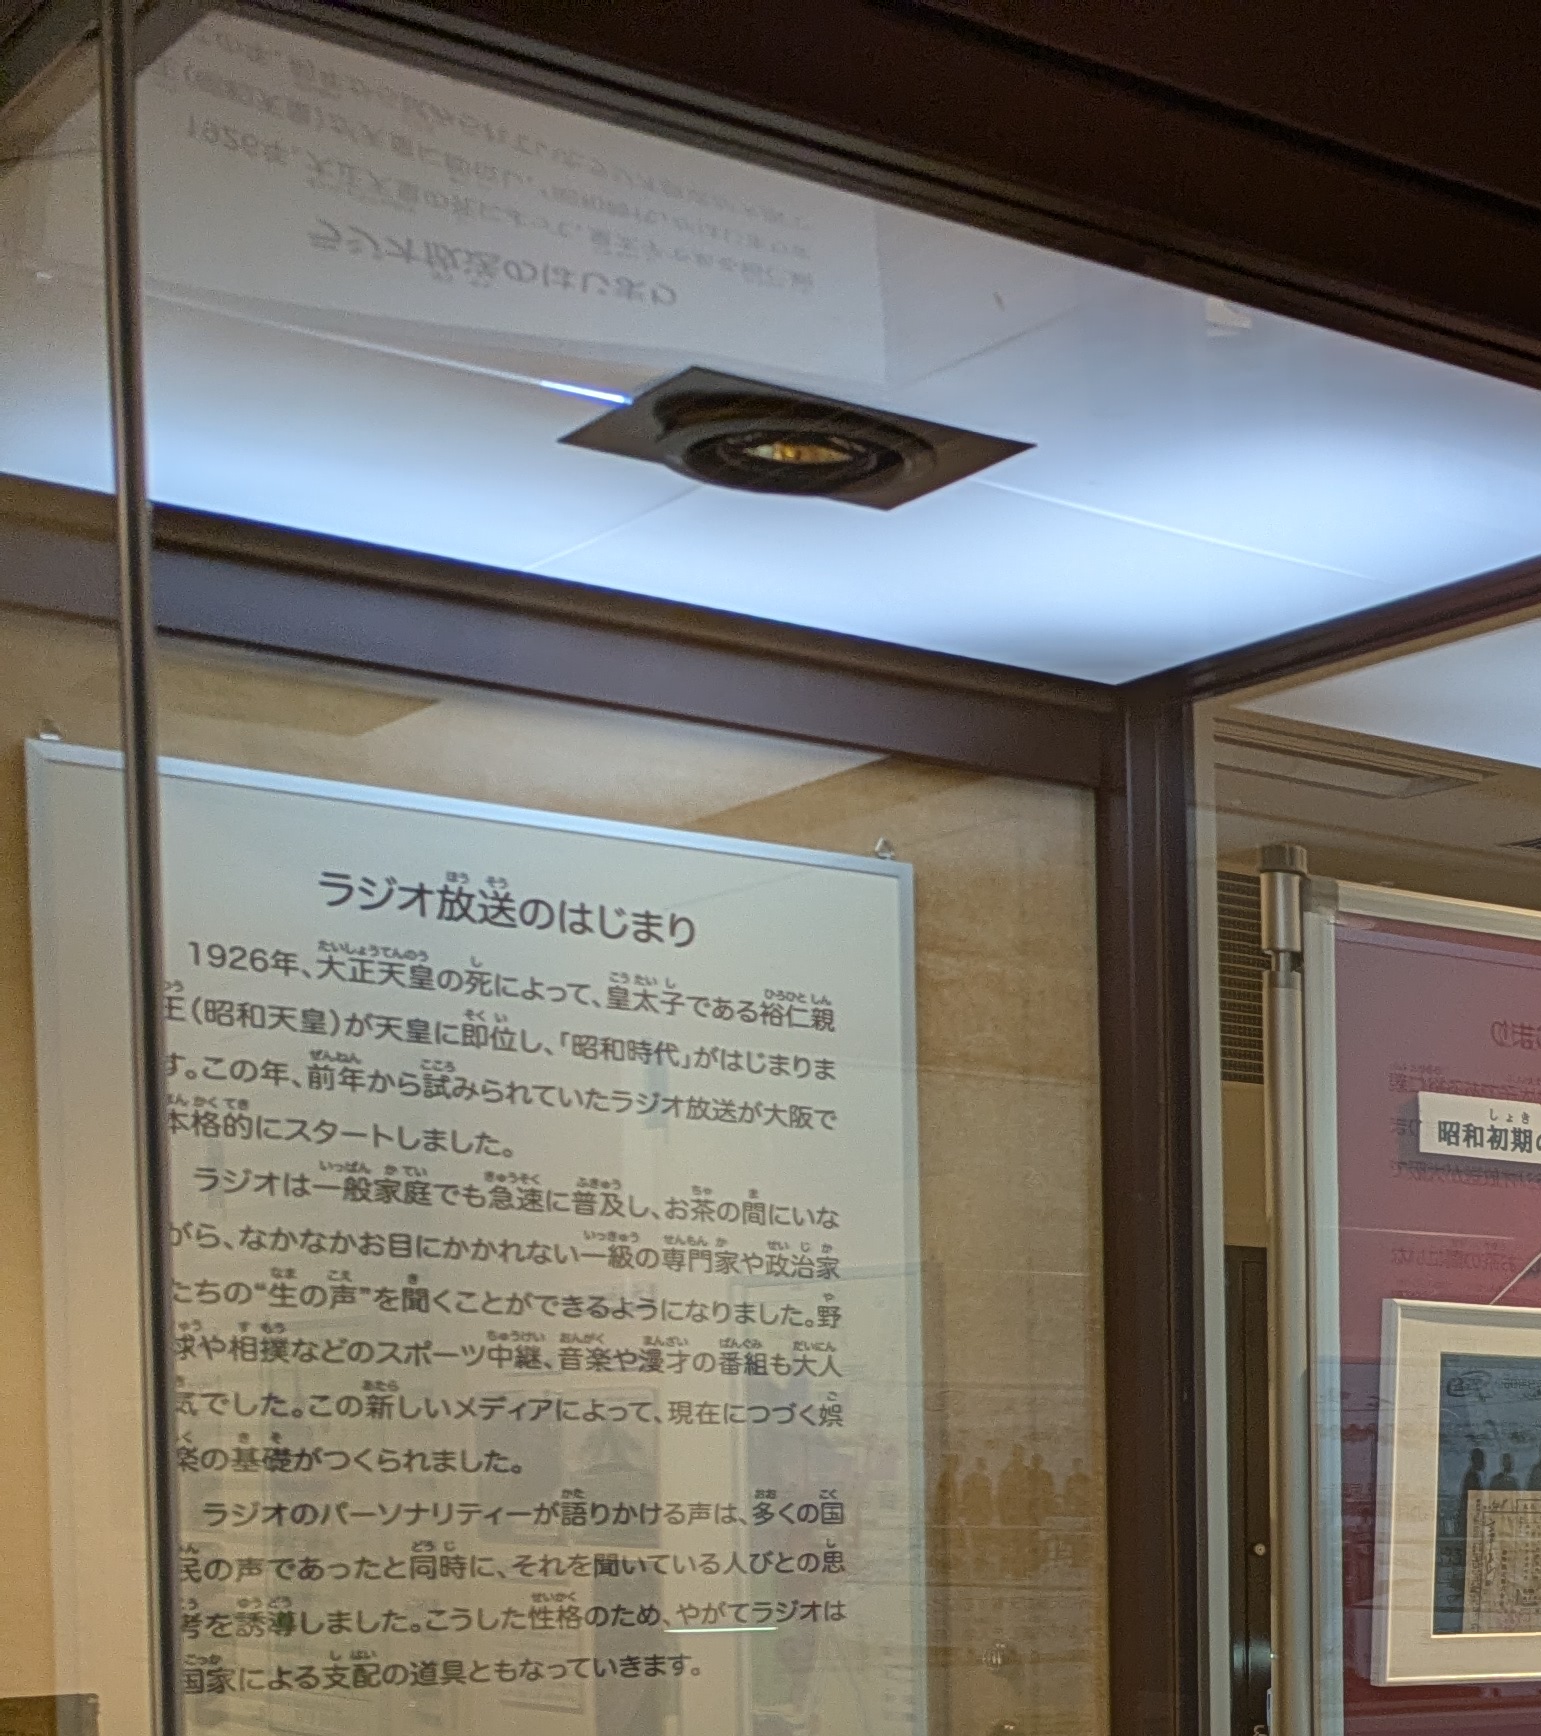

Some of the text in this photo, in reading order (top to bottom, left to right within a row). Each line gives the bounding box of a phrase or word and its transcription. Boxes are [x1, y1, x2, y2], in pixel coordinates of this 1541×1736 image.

[318, 870, 697, 948] ラジオ放送のはじまり
[188, 940, 836, 1033] 1926年、大正天皇の死によって、皇太子である裕仁親
[166, 1051, 837, 1131] す。この年、前年から試みられていたラジオ放送が大阪で
[1489, 1108, 1531, 1125] しょき
[168, 1111, 513, 1159] 本格的にスタートしました。
[194, 1166, 840, 1229] ラジオは一般家庭でも急速に普及し、お茶の間にいな
[169, 1220, 841, 1280] がら、なかなかお目にかかれない一級の専門家や政治家
[202, 1500, 845, 1527] ラジオのパーソナリティーが語りかける声は、多くの国
[181, 1550, 846, 1584] 民の声であったと同時に、それを聞いている人びとの思
[183, 1652, 702, 1695] 国家による支配の道具ともなっていきます。
